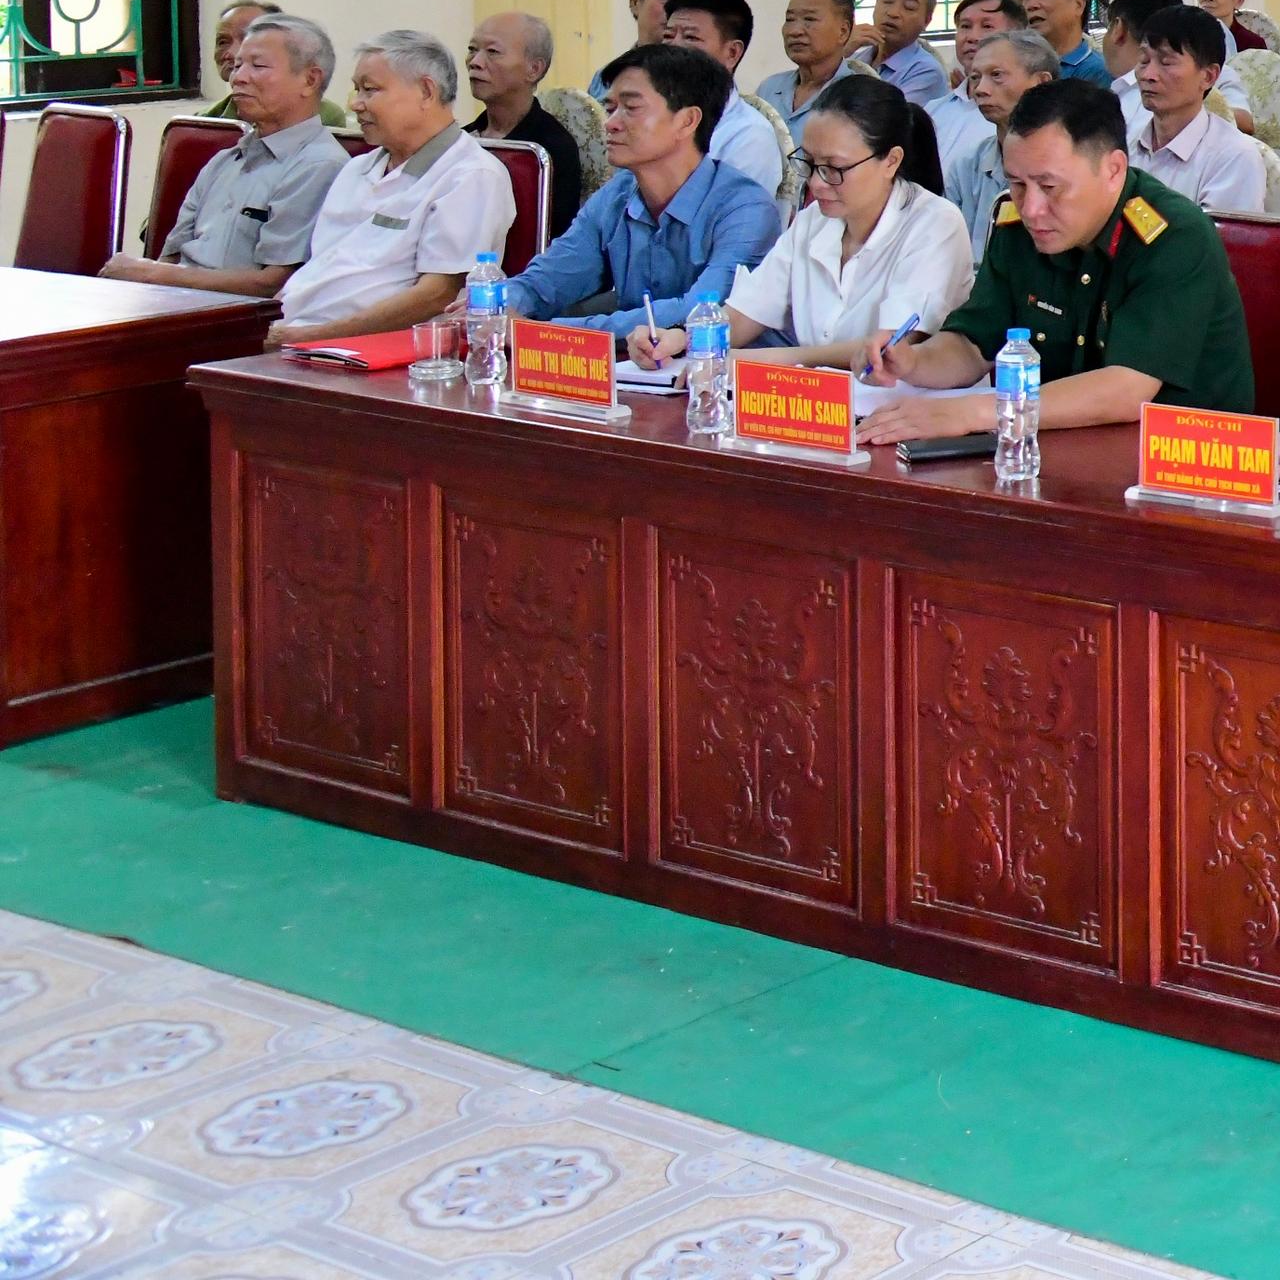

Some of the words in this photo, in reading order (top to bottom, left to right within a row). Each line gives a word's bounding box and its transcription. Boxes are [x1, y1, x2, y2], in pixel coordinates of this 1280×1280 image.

[544, 351, 560, 379] THỊ
[590, 352, 609, 382] HUẾ
[767, 371, 798, 384] ĐỒNG
[800, 376, 820, 387] CHÍ
[741, 386, 787, 418] NGUYỄN
[789, 393, 812, 422] VĂN
[815, 400, 847, 427] SANH
[1176, 415, 1214, 429] ĐỒNG
[1217, 420, 1242, 432] CHÍ
[1149, 435, 1196, 468] PHẠM
[1201, 438, 1233, 470] VĂN
[1237, 446, 1270, 475] TAM
